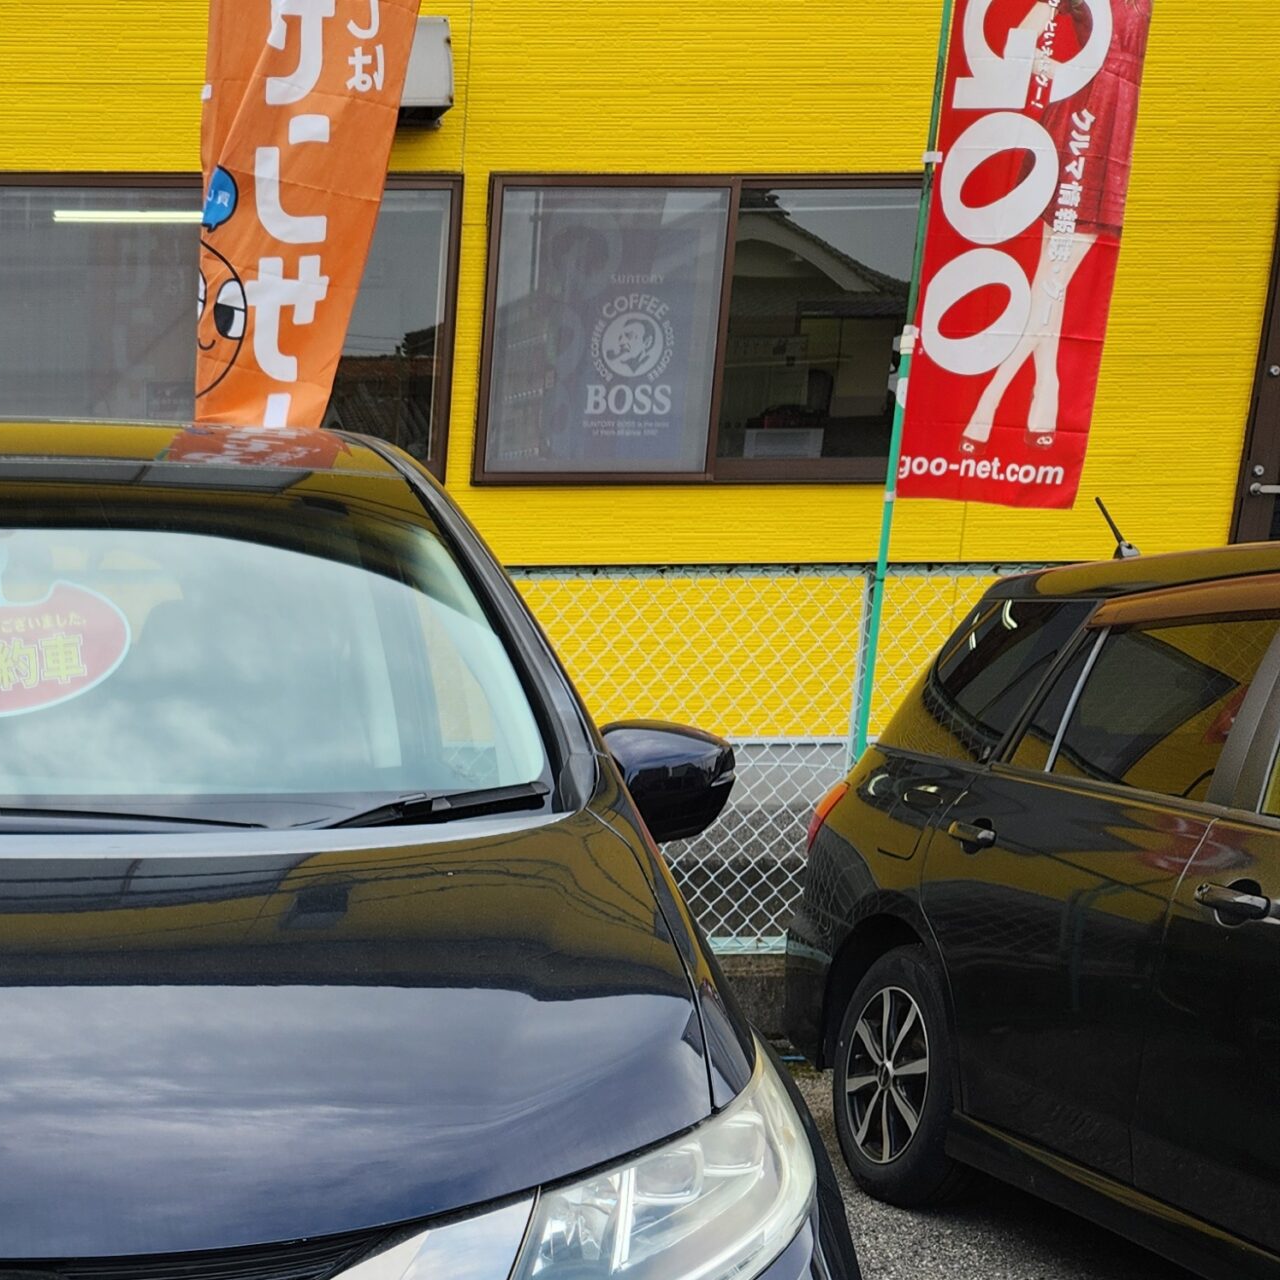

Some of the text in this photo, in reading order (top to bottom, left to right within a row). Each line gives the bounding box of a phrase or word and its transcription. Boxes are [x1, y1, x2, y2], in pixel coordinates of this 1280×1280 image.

[602, 293, 670, 320] COFFEE
[584, 384, 672, 415] BOSS
[898, 455, 1065, 485] goo-net.com
